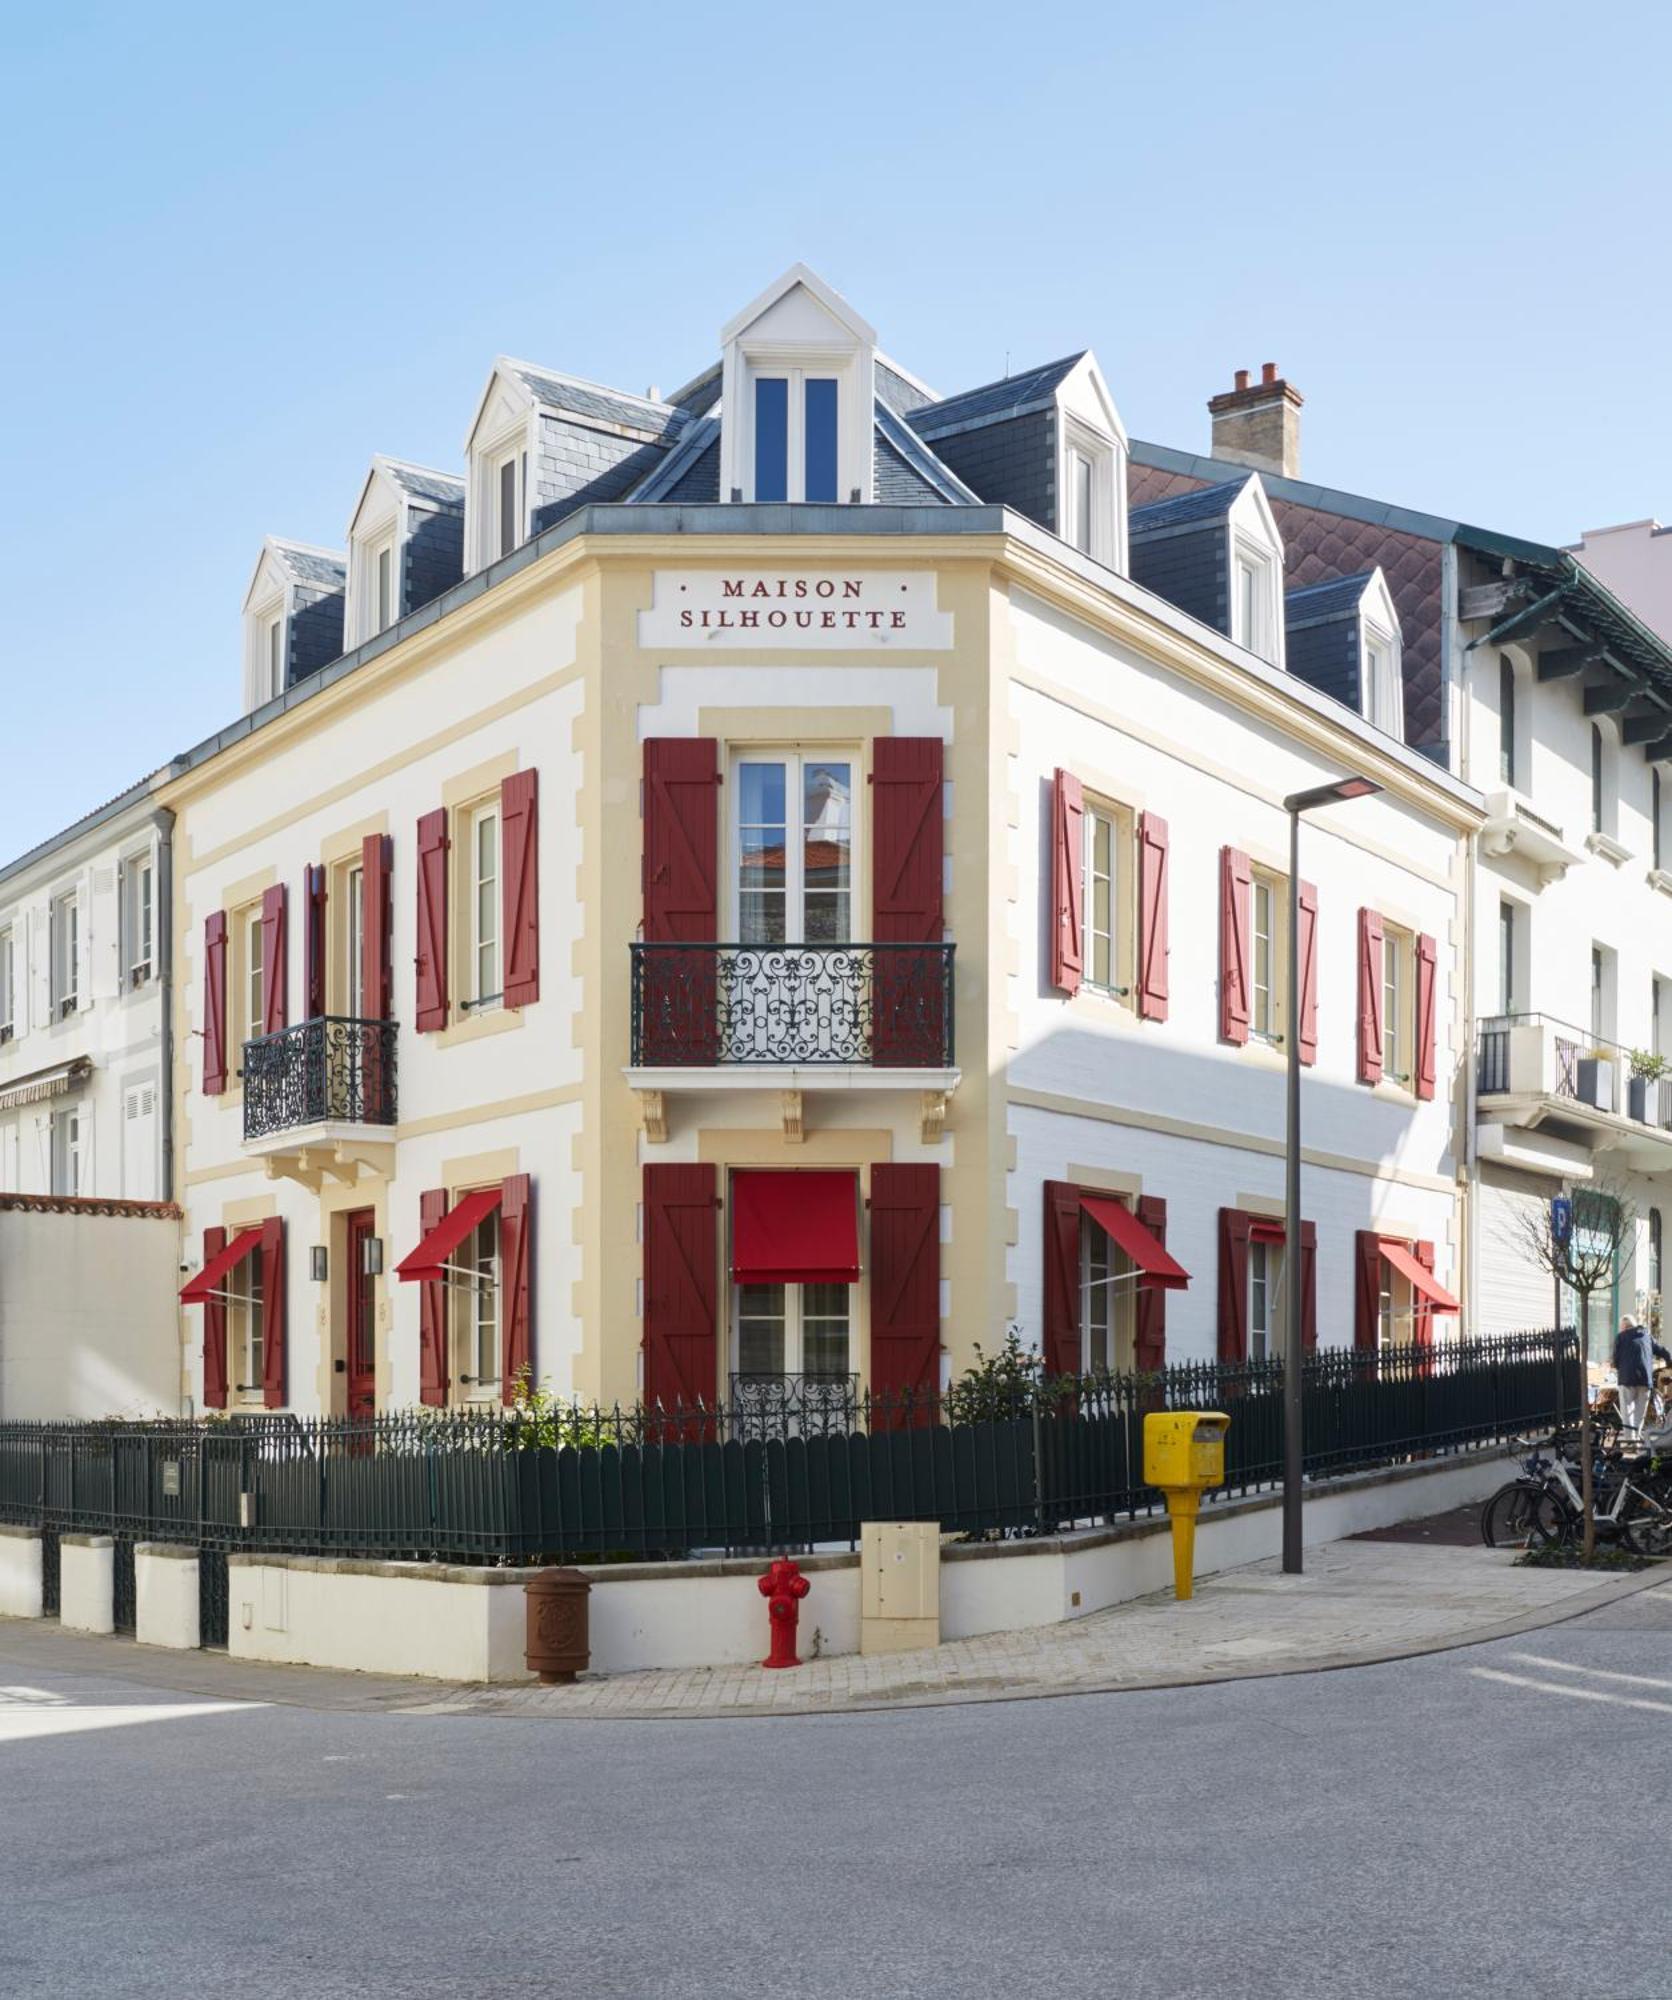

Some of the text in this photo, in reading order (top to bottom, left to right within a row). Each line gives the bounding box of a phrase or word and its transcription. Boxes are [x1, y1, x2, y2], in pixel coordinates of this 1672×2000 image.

[722, 580, 863, 598] MAISON
[680, 610, 906, 628] SILHOUETTE
[1557, 1207, 1566, 1238] P
